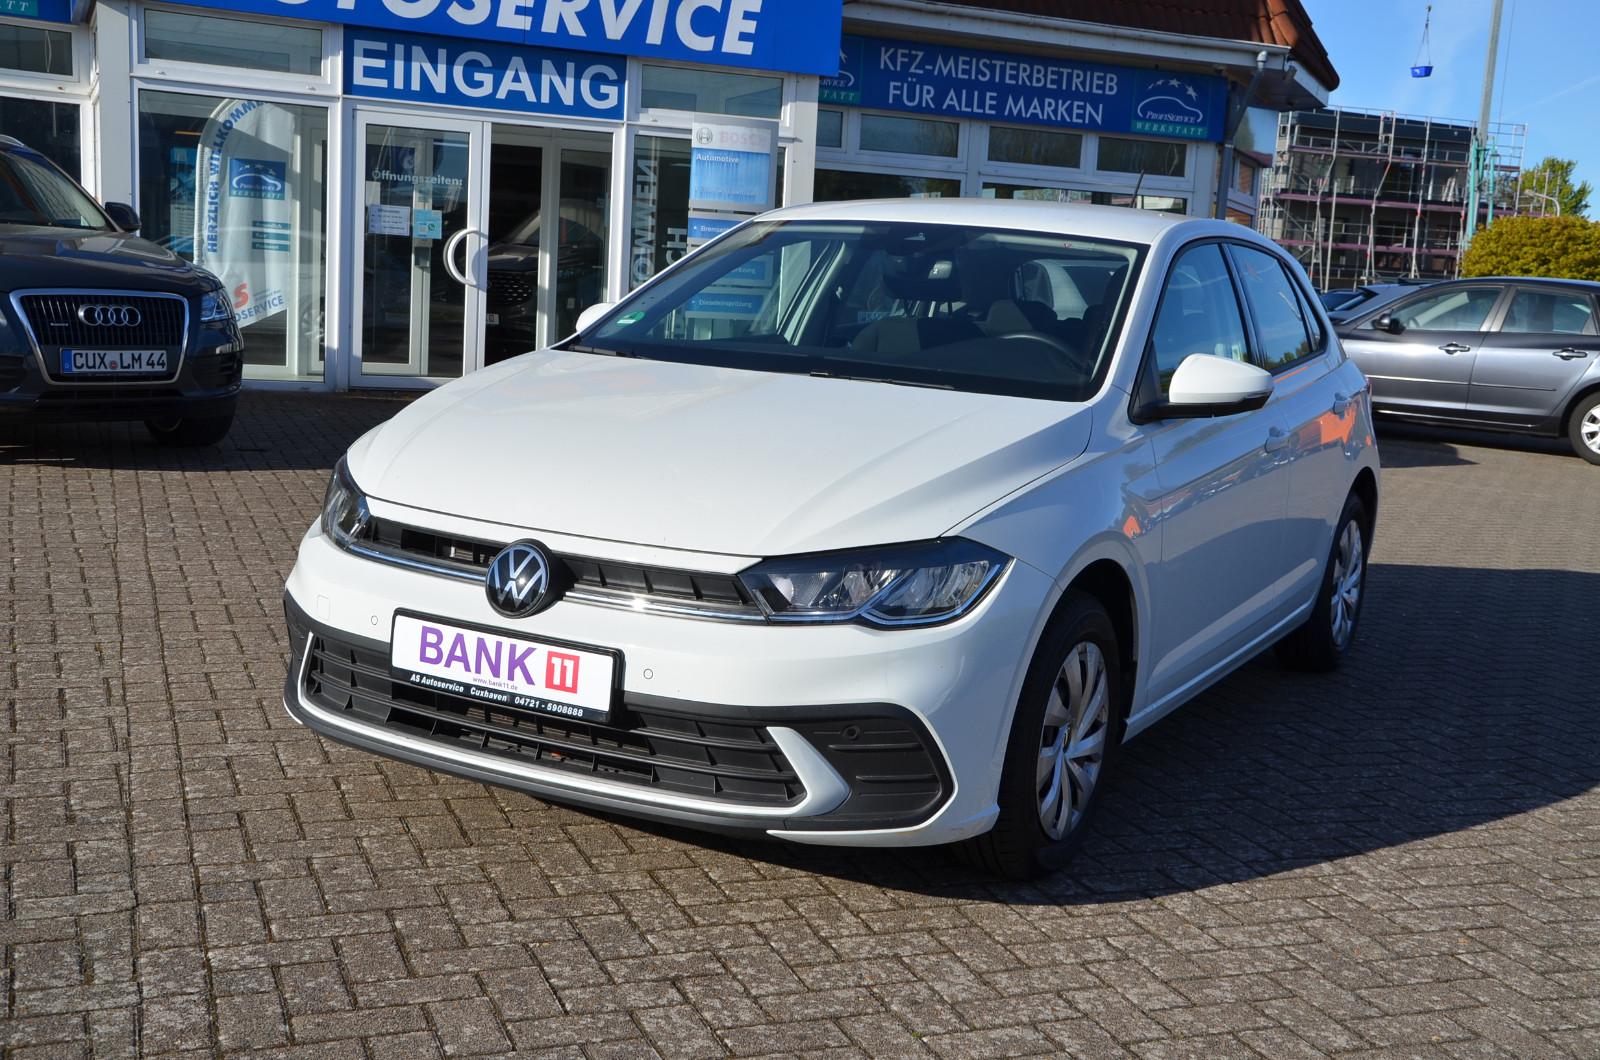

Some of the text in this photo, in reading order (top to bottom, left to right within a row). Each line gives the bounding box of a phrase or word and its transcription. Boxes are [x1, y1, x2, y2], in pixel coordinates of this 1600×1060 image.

[352, 39, 620, 109] EINGANG
[879, 46, 1118, 96] KFZ-MEISTERBETRIEB
[888, 79, 1103, 125] FÜR ALLE MARKEN
[1136, 121, 1204, 136] WERKSTATT
[372, 167, 463, 186] Öffnungszeiten:
[696, 153, 740, 163] Automotive
[207, 181, 219, 253] HERZLICH
[73, 352, 166, 370] CUX LM 44
[419, 625, 576, 689] BANK 11
[410, 673, 421, 684] AS
[421, 675, 465, 694] Autoservice
[470, 686, 508, 703] Cuxhaven
[514, 695, 541, 710] 04721
[472, 676, 519, 692] www.bank11.de
